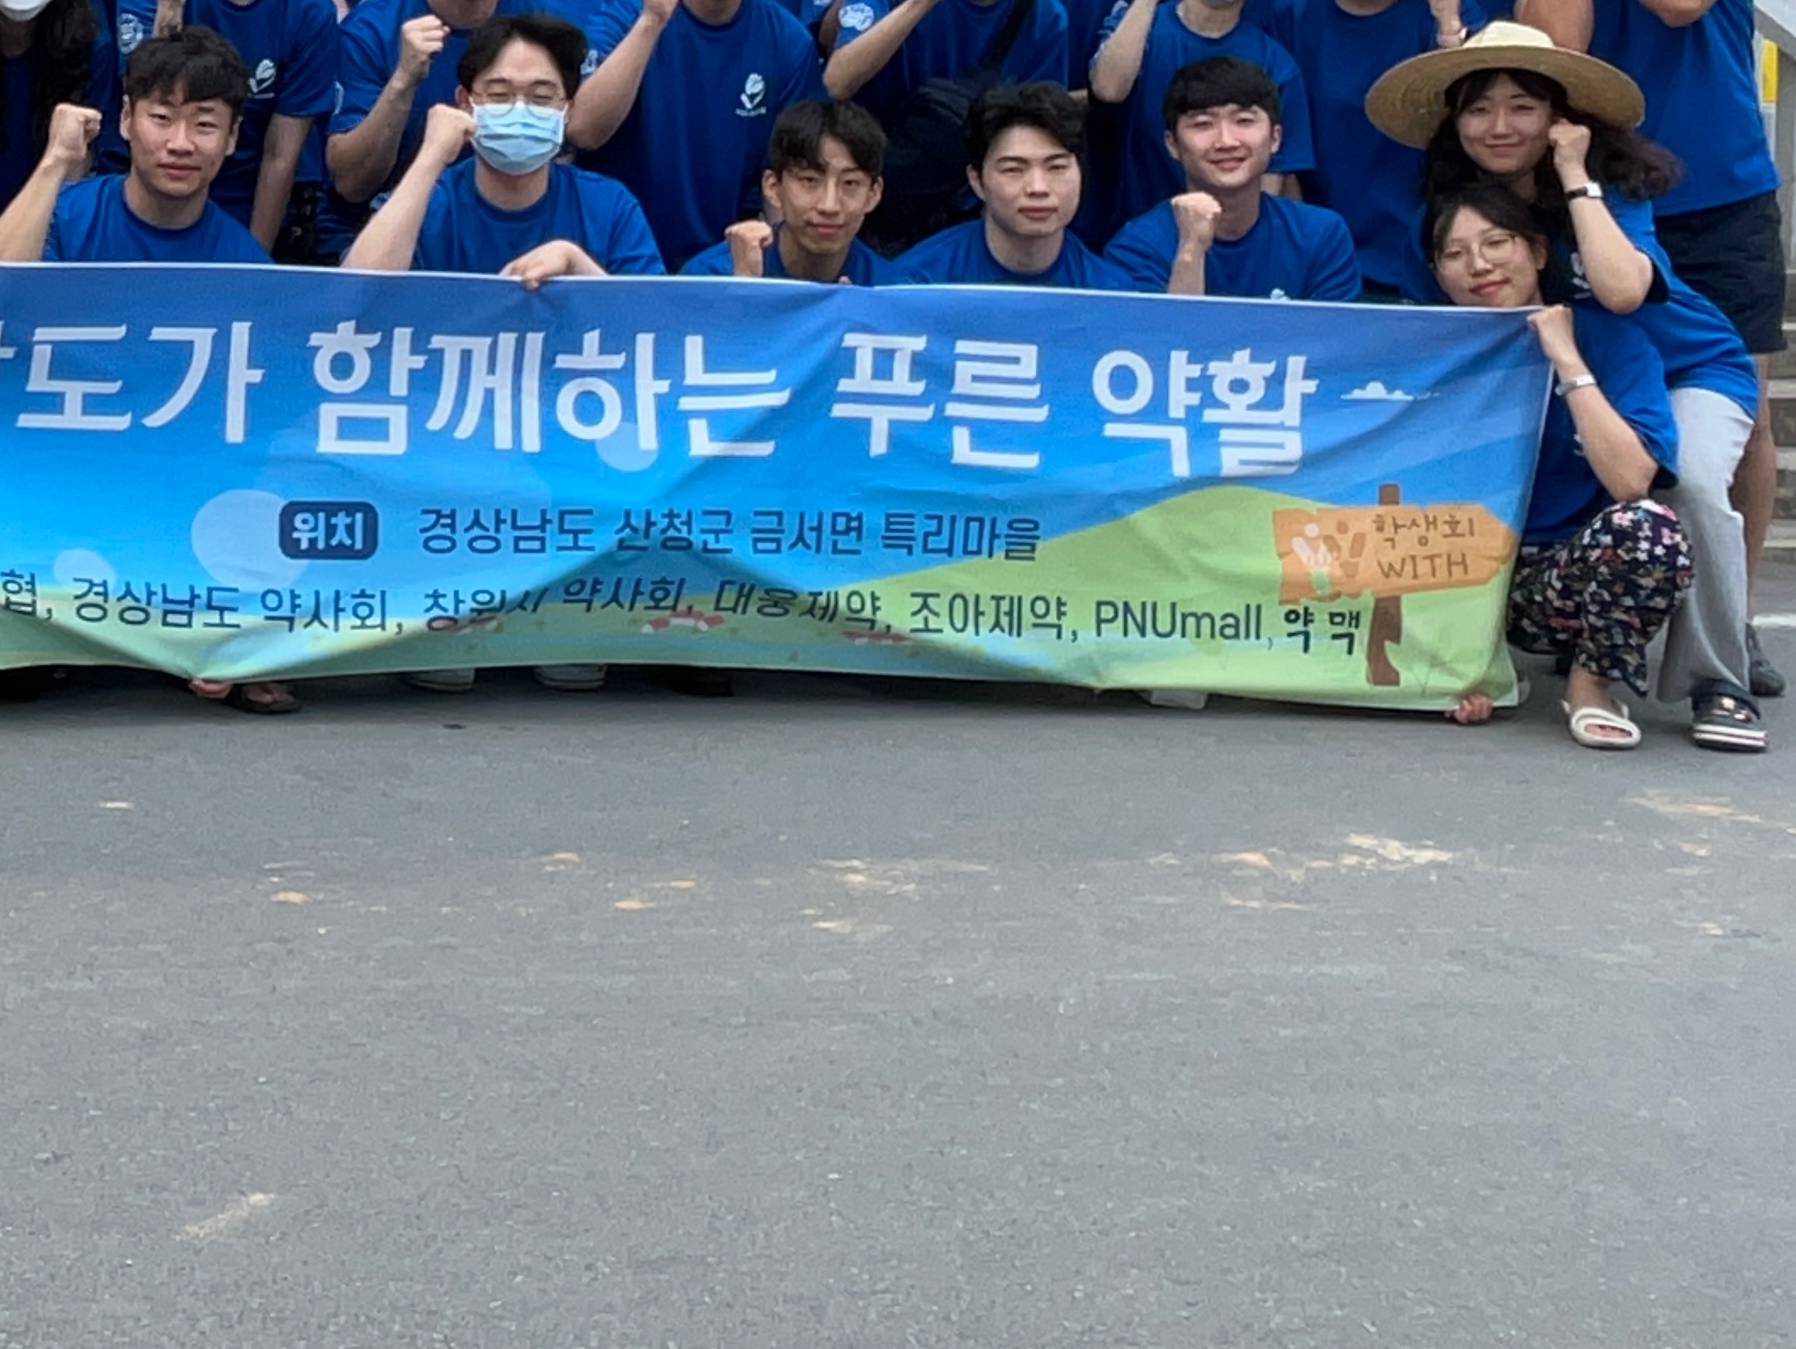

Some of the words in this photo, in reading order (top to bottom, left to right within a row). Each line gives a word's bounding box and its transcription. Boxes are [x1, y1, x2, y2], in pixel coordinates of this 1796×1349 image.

[306, 318, 791, 457] 함께하는
[828, 332, 1050, 469] 푸른
[1092, 346, 1320, 478] 약활
[291, 510, 365, 551] 위치
[418, 507, 596, 555] 경상남도
[614, 508, 734, 556] 산청군
[750, 509, 865, 556] 금서면
[880, 511, 1042, 562] 특리마을
[1370, 512, 1477, 550] 학생회
[1376, 553, 1471, 581] WITH
[71, 575, 242, 630] 경상남도
[259, 587, 405, 636] 약사회,
[562, 576, 694, 616] 약사회,
[908, 591, 1079, 643] 조아제약,
[1094, 599, 1273, 650] PNUmall,
